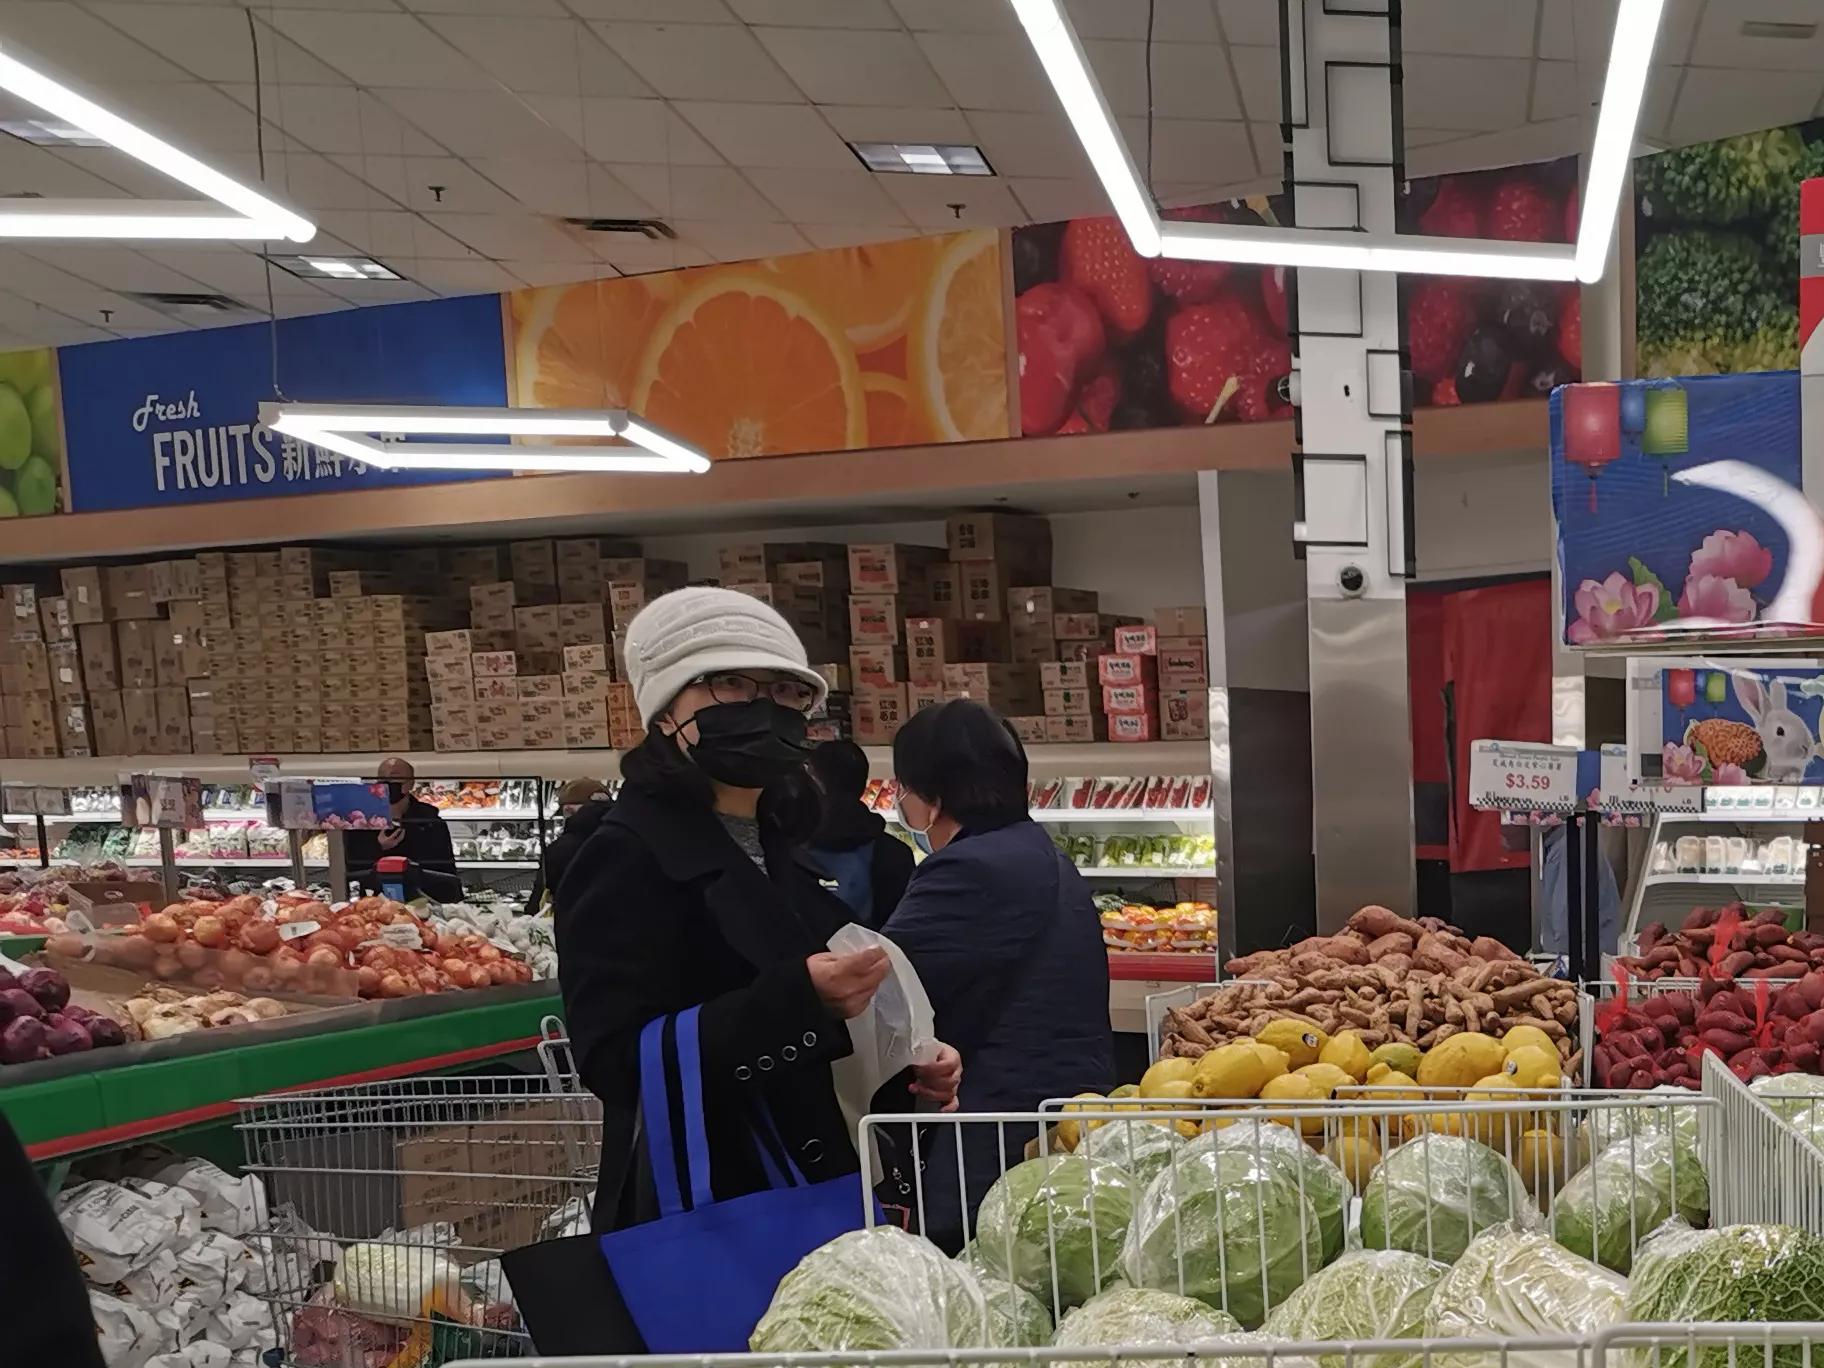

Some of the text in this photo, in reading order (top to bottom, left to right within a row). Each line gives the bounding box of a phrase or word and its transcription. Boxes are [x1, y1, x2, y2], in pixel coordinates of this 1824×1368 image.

[133, 390, 200, 432] Fresh
[153, 422, 275, 491] FRUITS
[1505, 772, 1551, 790] $3.59
